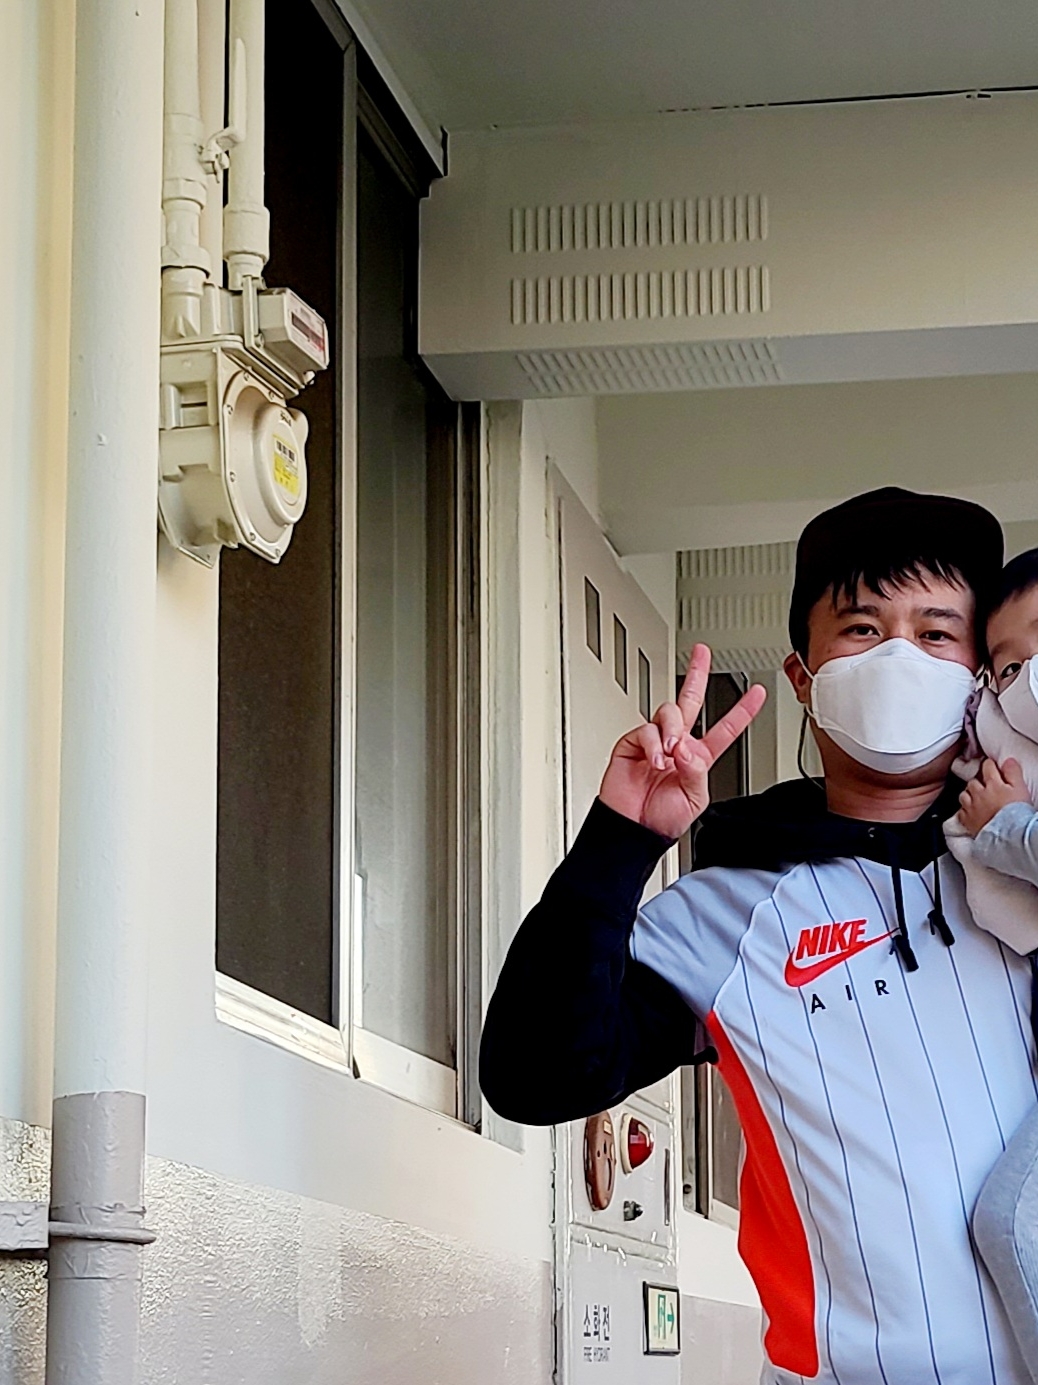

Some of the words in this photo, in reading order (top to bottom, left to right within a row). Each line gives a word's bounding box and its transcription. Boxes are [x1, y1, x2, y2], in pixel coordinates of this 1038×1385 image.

[795, 918, 868, 961] NIKE
[810, 979, 890, 1014] AIR
[583, 1303, 611, 1342] 소화전
